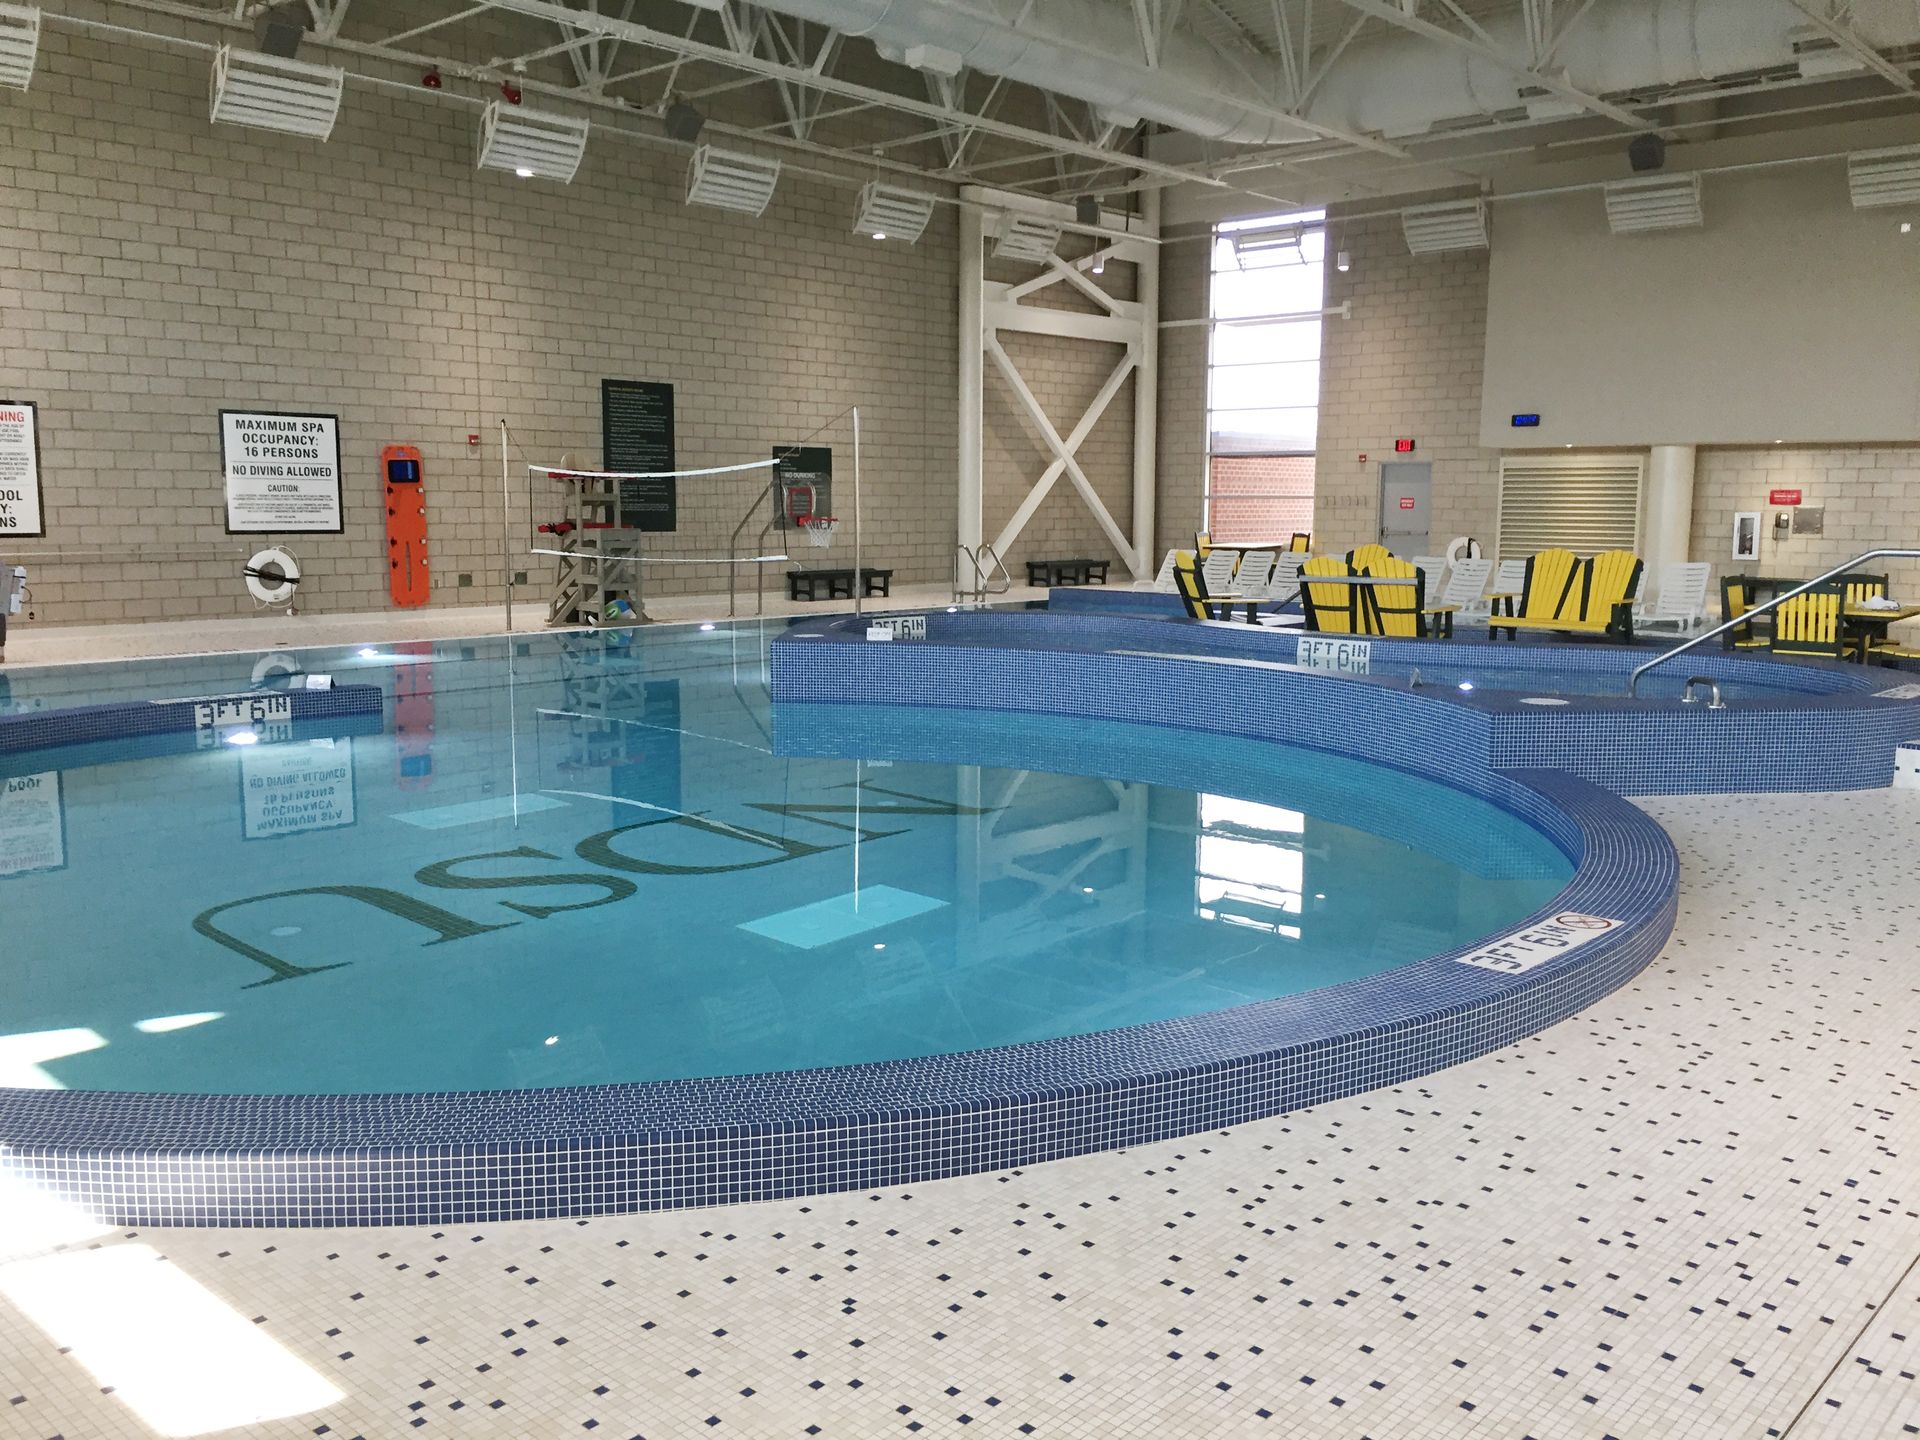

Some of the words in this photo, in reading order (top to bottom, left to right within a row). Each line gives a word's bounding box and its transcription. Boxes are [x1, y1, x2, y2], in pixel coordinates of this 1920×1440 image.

[235, 419, 297, 432] MAXIMUM
[301, 422, 324, 433] SPA
[242, 433, 319, 446] OCCUPANCY:
[245, 446, 259, 457] 16
[262, 447, 319, 459] PERSONS
[232, 465, 247, 475] NO
[250, 465, 284, 476] DIVING
[286, 466, 332, 477] ALLOWED
[200, 699, 243, 726] 3FT
[250, 697, 287, 721] 6IN
[192, 778, 1011, 988] NDSU
[1471, 942, 1534, 970] 3FT
[1520, 924, 1576, 948] 6IN
